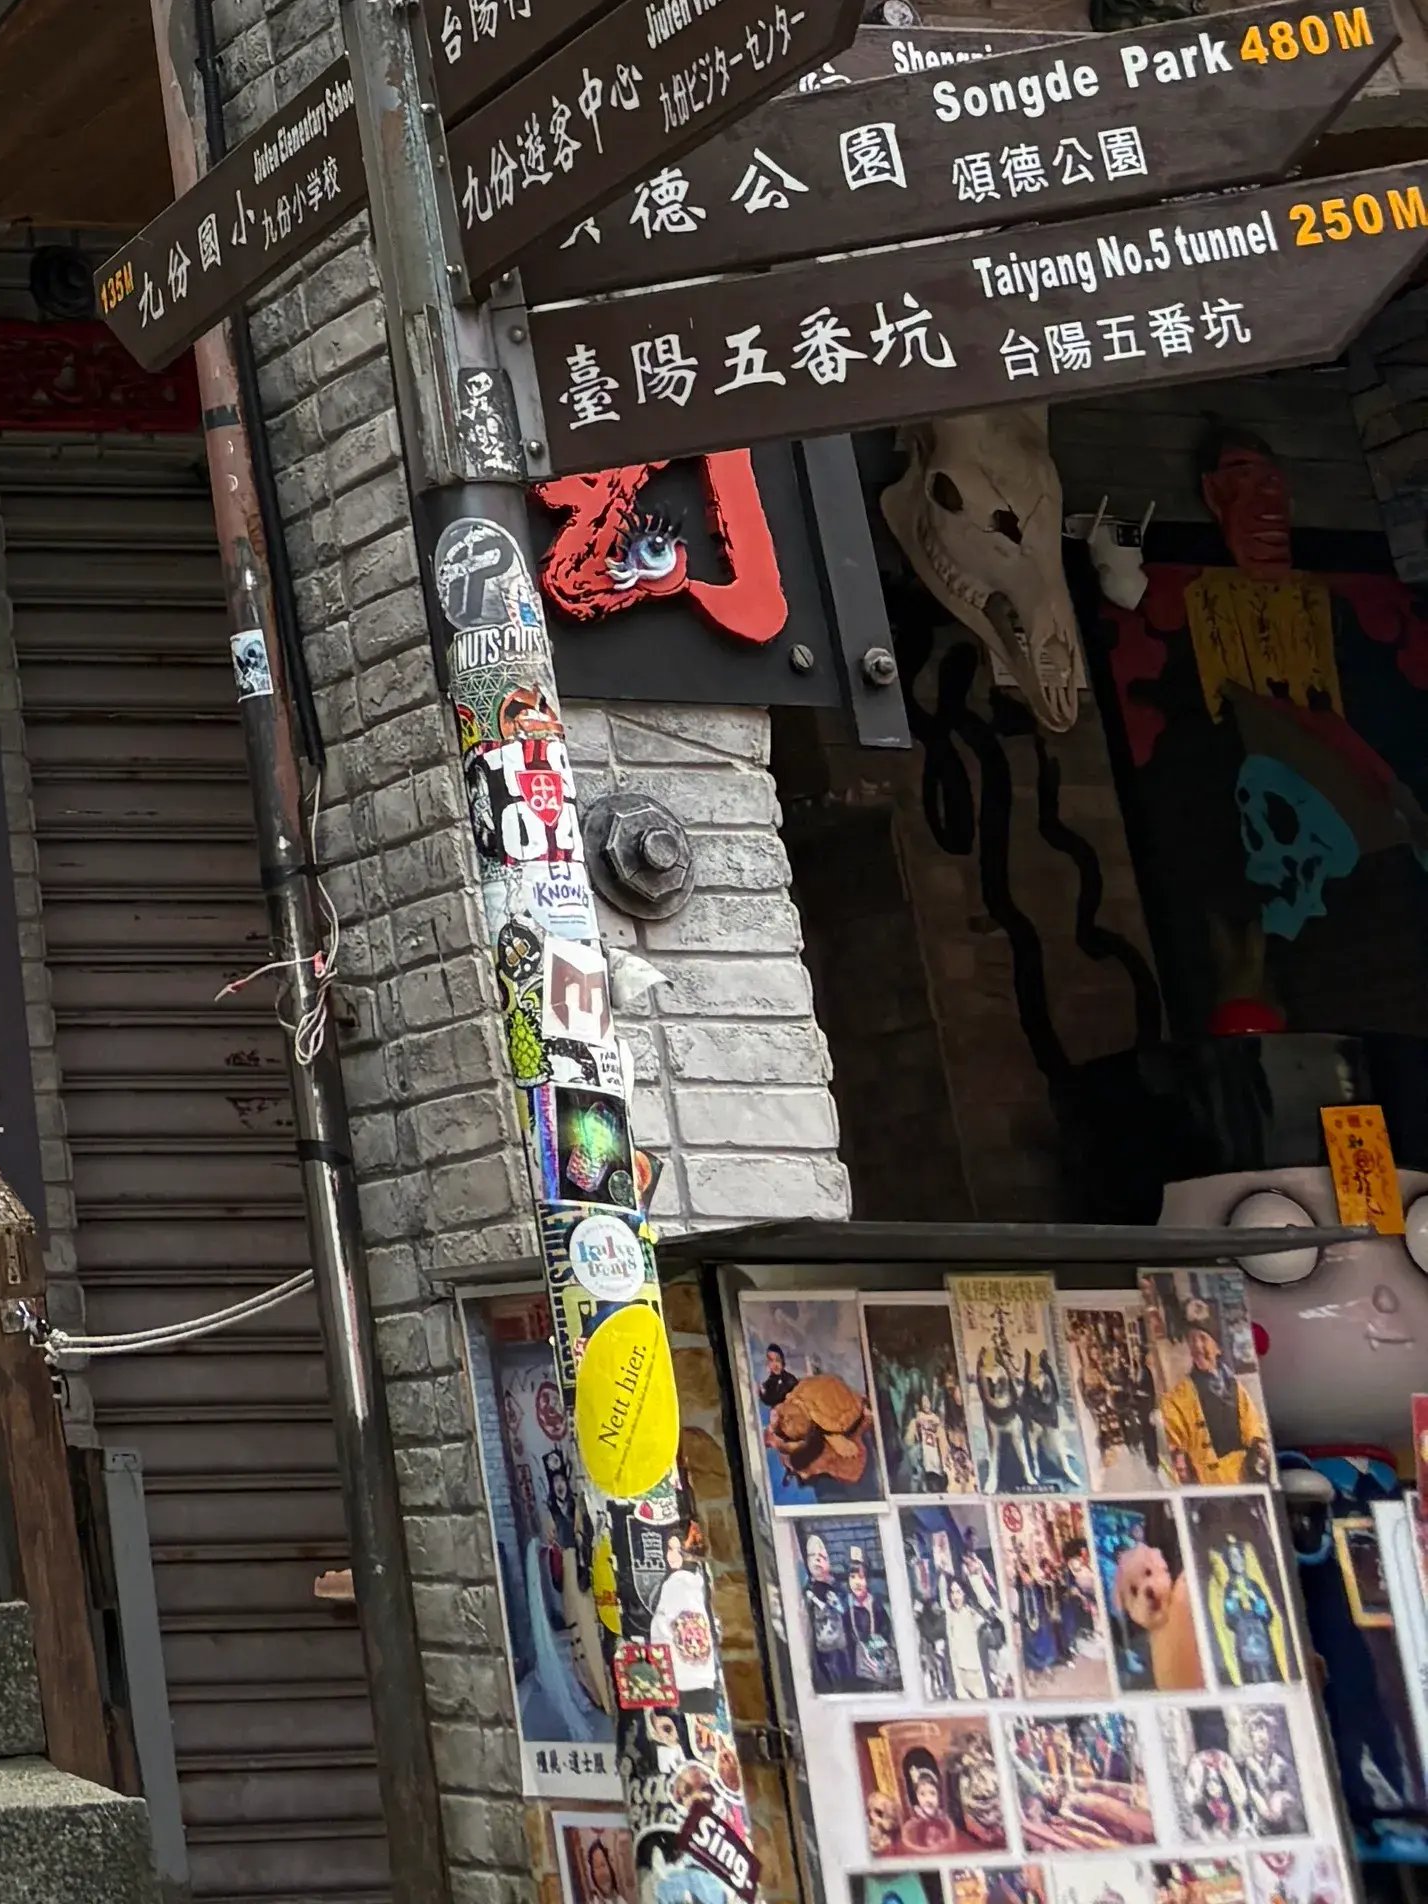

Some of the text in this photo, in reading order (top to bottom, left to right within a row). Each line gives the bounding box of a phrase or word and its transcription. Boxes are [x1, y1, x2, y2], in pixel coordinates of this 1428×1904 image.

[932, 54, 1101, 125] Songde
[1121, 30, 1234, 92] Park
[558, 120, 909, 250] 德公園
[950, 124, 1147, 206] 頌德公園
[137, 189, 256, 329] 九份國小
[972, 248, 1100, 305] Taiyang
[1099, 224, 1175, 280] No.5
[1173, 209, 1280, 267] tunnel
[556, 289, 959, 433] 臺陽五番坑
[997, 295, 1253, 384] 台陽五番坑
[691, 1813, 754, 1891] Sing.
